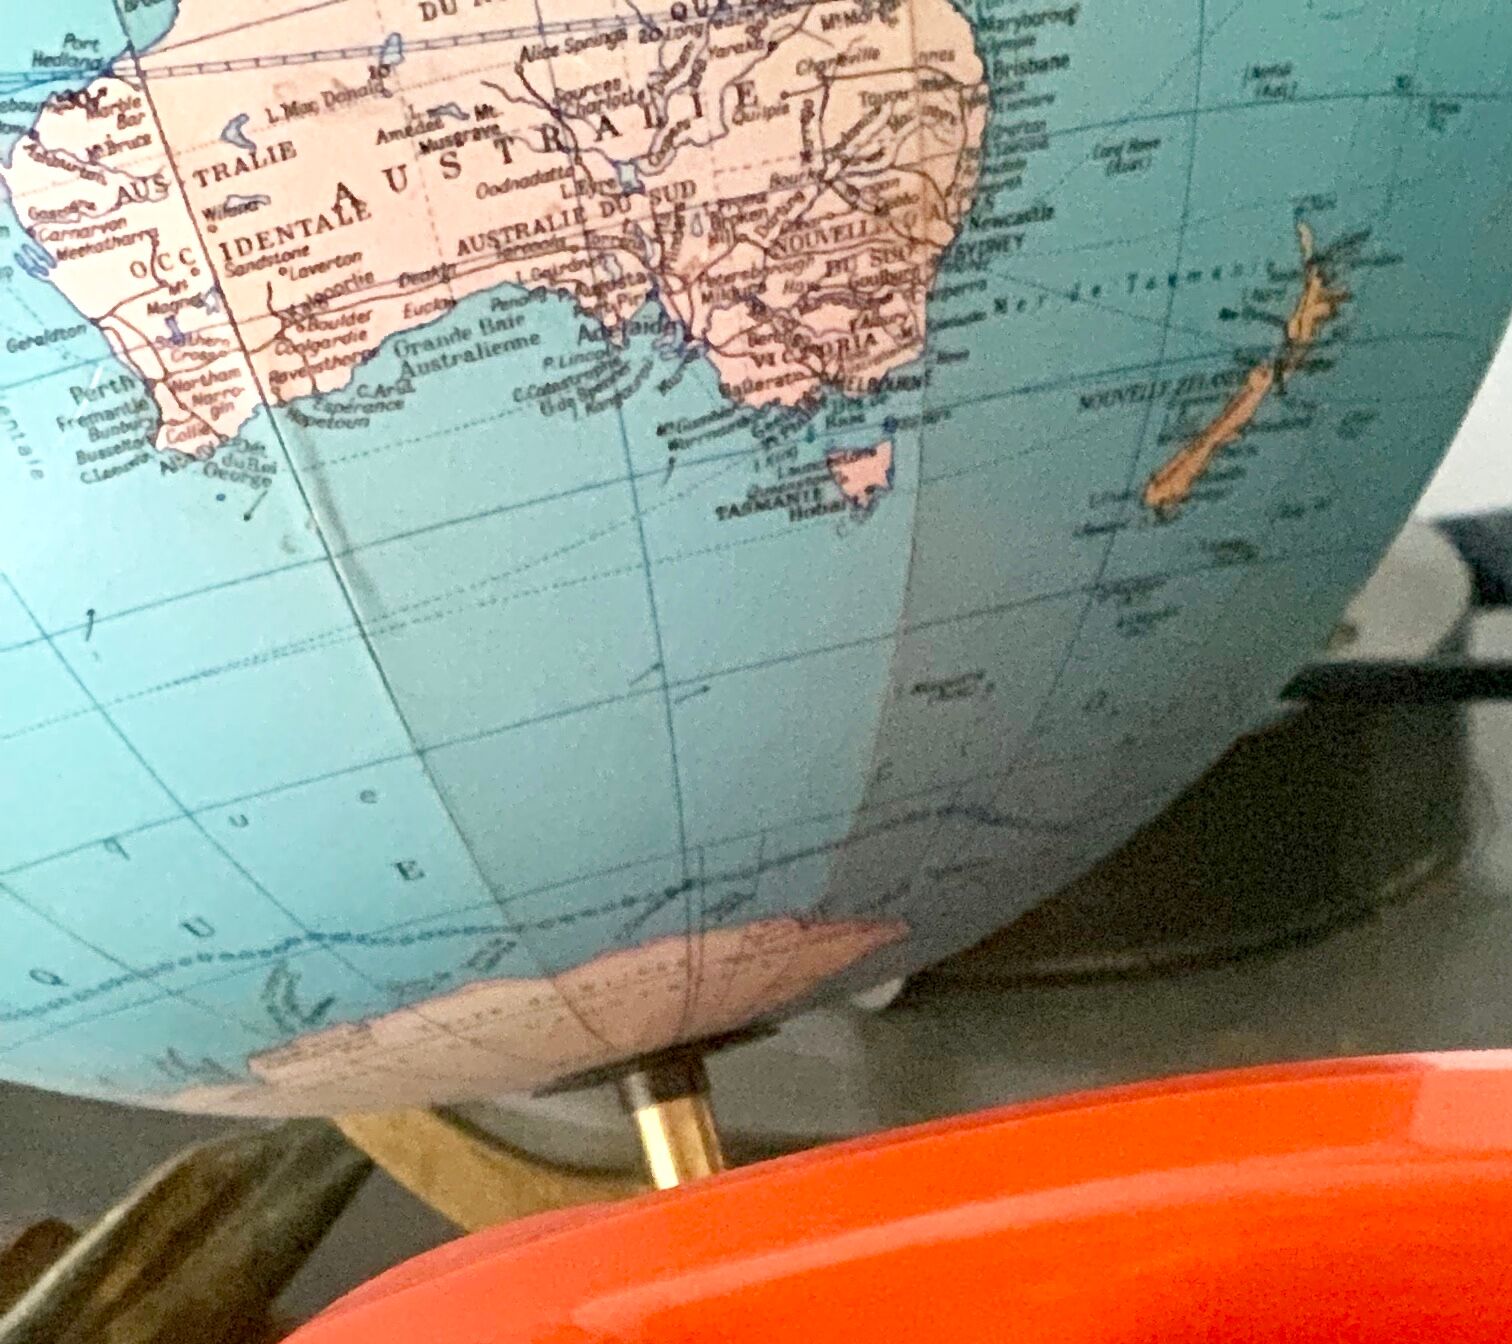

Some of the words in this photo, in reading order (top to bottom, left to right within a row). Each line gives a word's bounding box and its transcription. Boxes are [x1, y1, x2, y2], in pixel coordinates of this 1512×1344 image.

[457, 206, 590, 257] AUSTRALIE
[400, 332, 541, 383] Australienne
[69, 373, 137, 406] Perth
